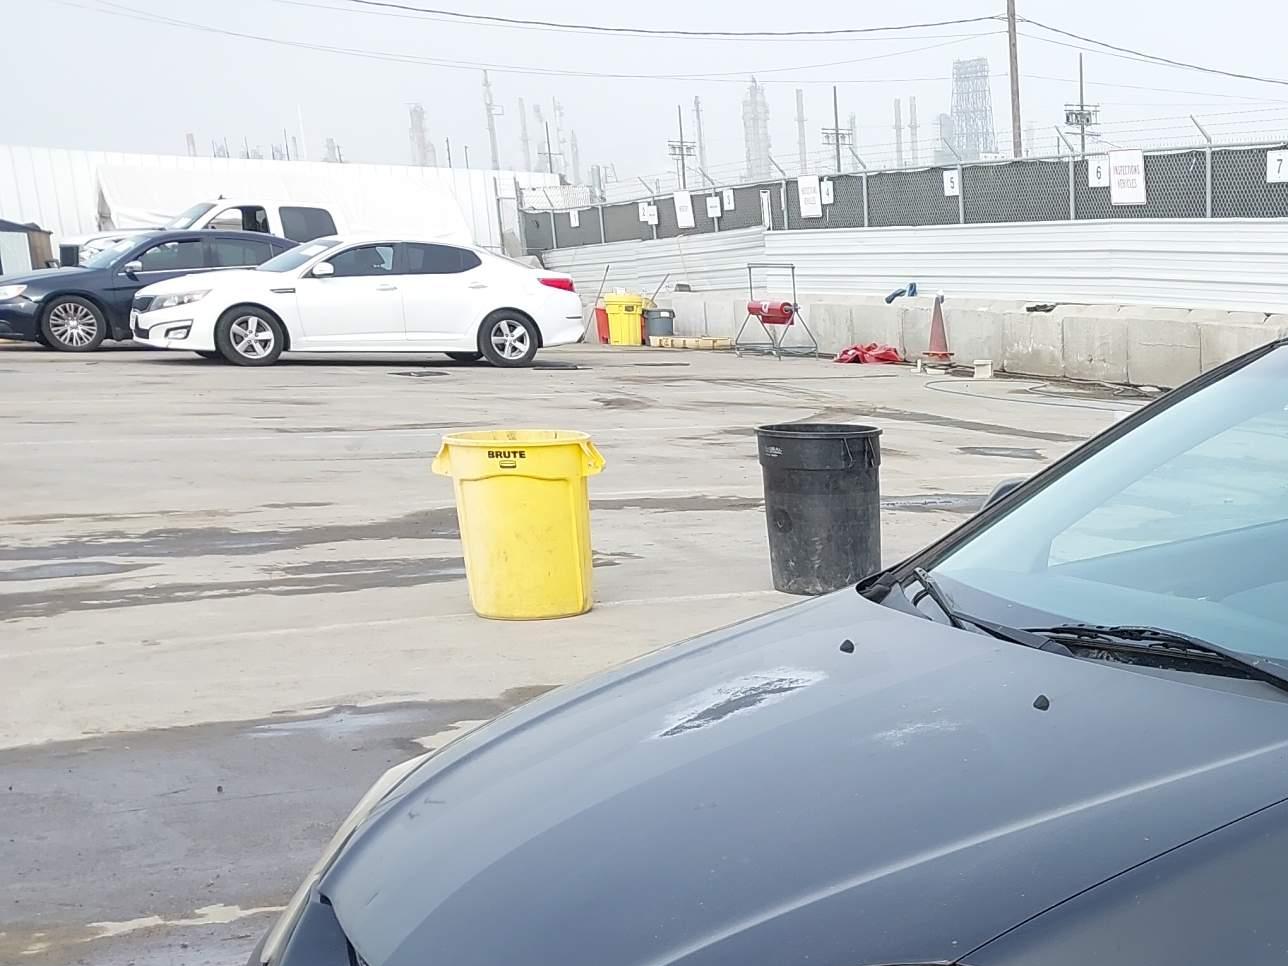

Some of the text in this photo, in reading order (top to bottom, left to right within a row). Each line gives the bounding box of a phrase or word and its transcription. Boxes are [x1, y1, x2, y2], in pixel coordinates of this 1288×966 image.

[1095, 165, 1102, 180] 6
[1276, 158, 1284, 175] 7
[949, 176, 955, 189] 5
[487, 450, 526, 459] BRUTE
